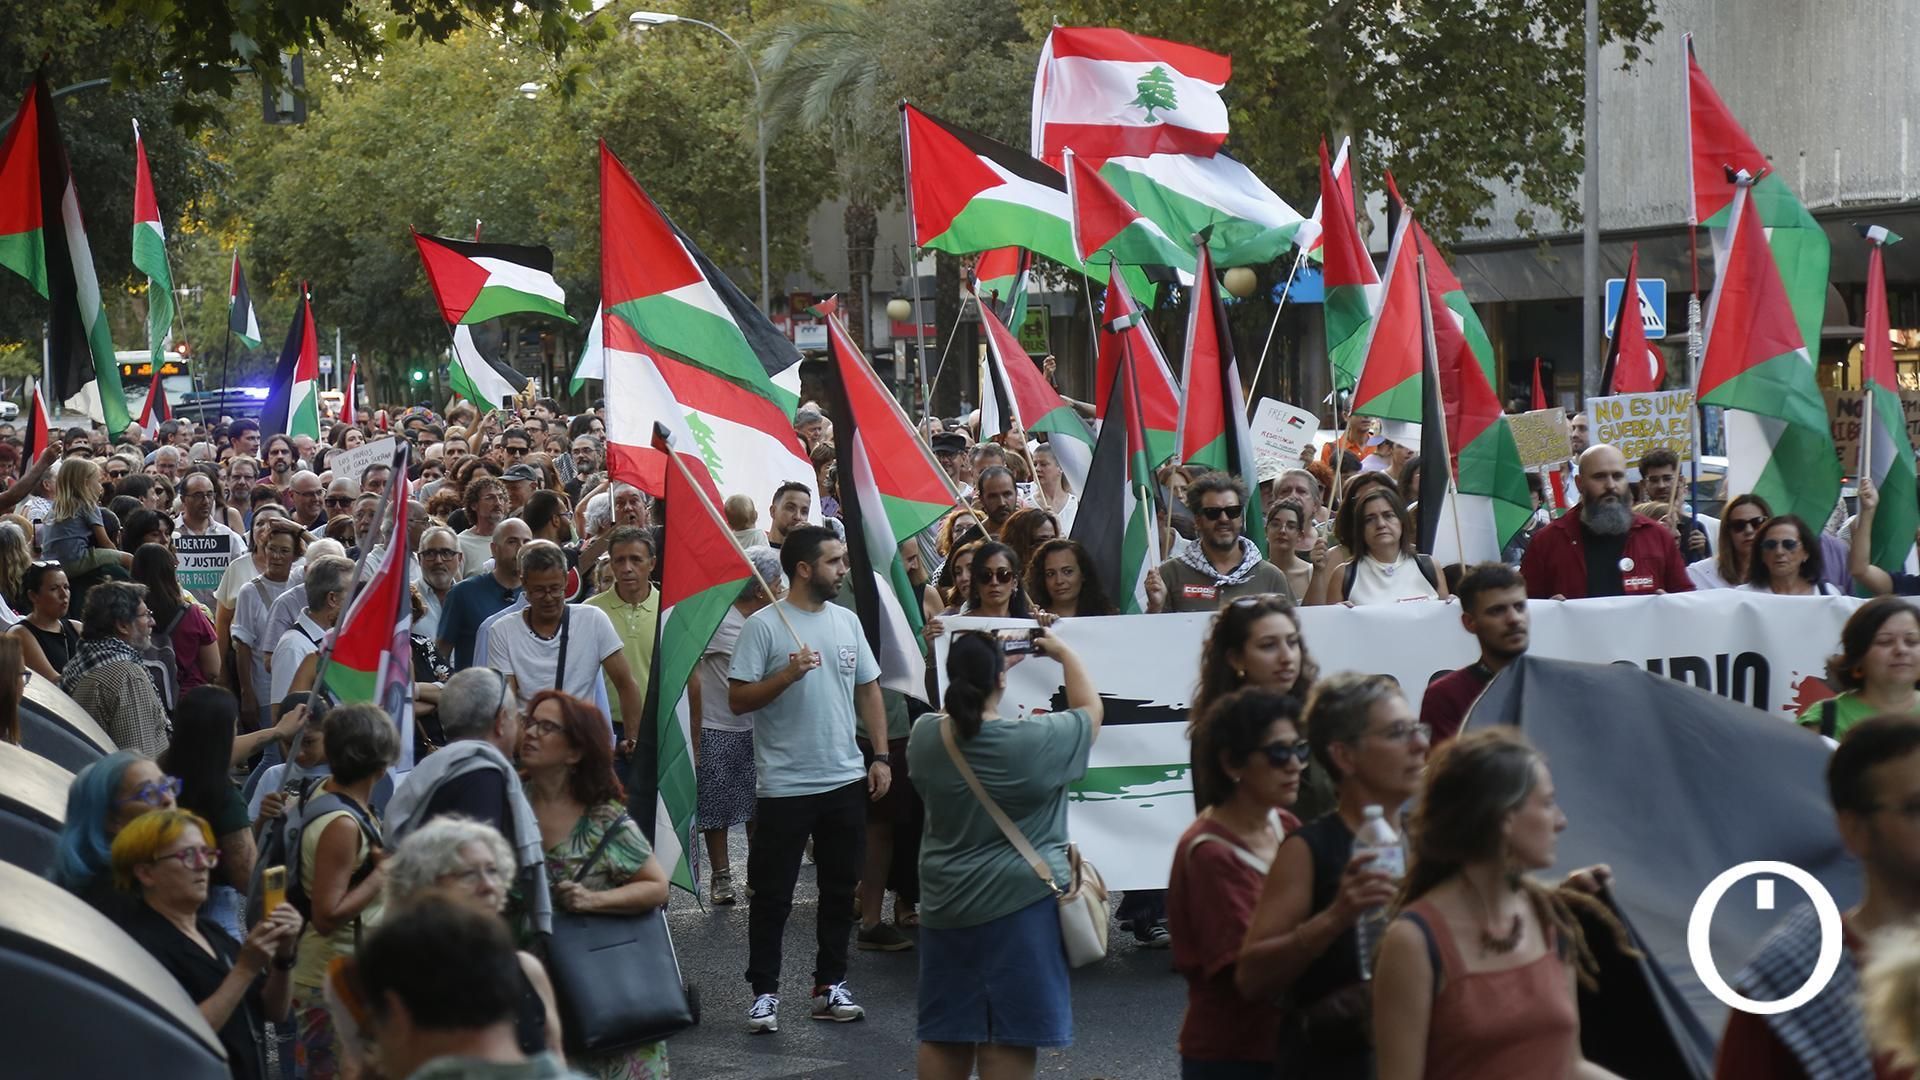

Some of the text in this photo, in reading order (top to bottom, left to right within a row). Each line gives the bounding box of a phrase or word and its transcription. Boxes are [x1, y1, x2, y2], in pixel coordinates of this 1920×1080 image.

[1595, 400, 1624, 424] NO
[1630, 398, 1653, 417] ES
[174, 538, 218, 550] LIBERTAD
[184, 556, 230, 568] Y JUSTICIA
